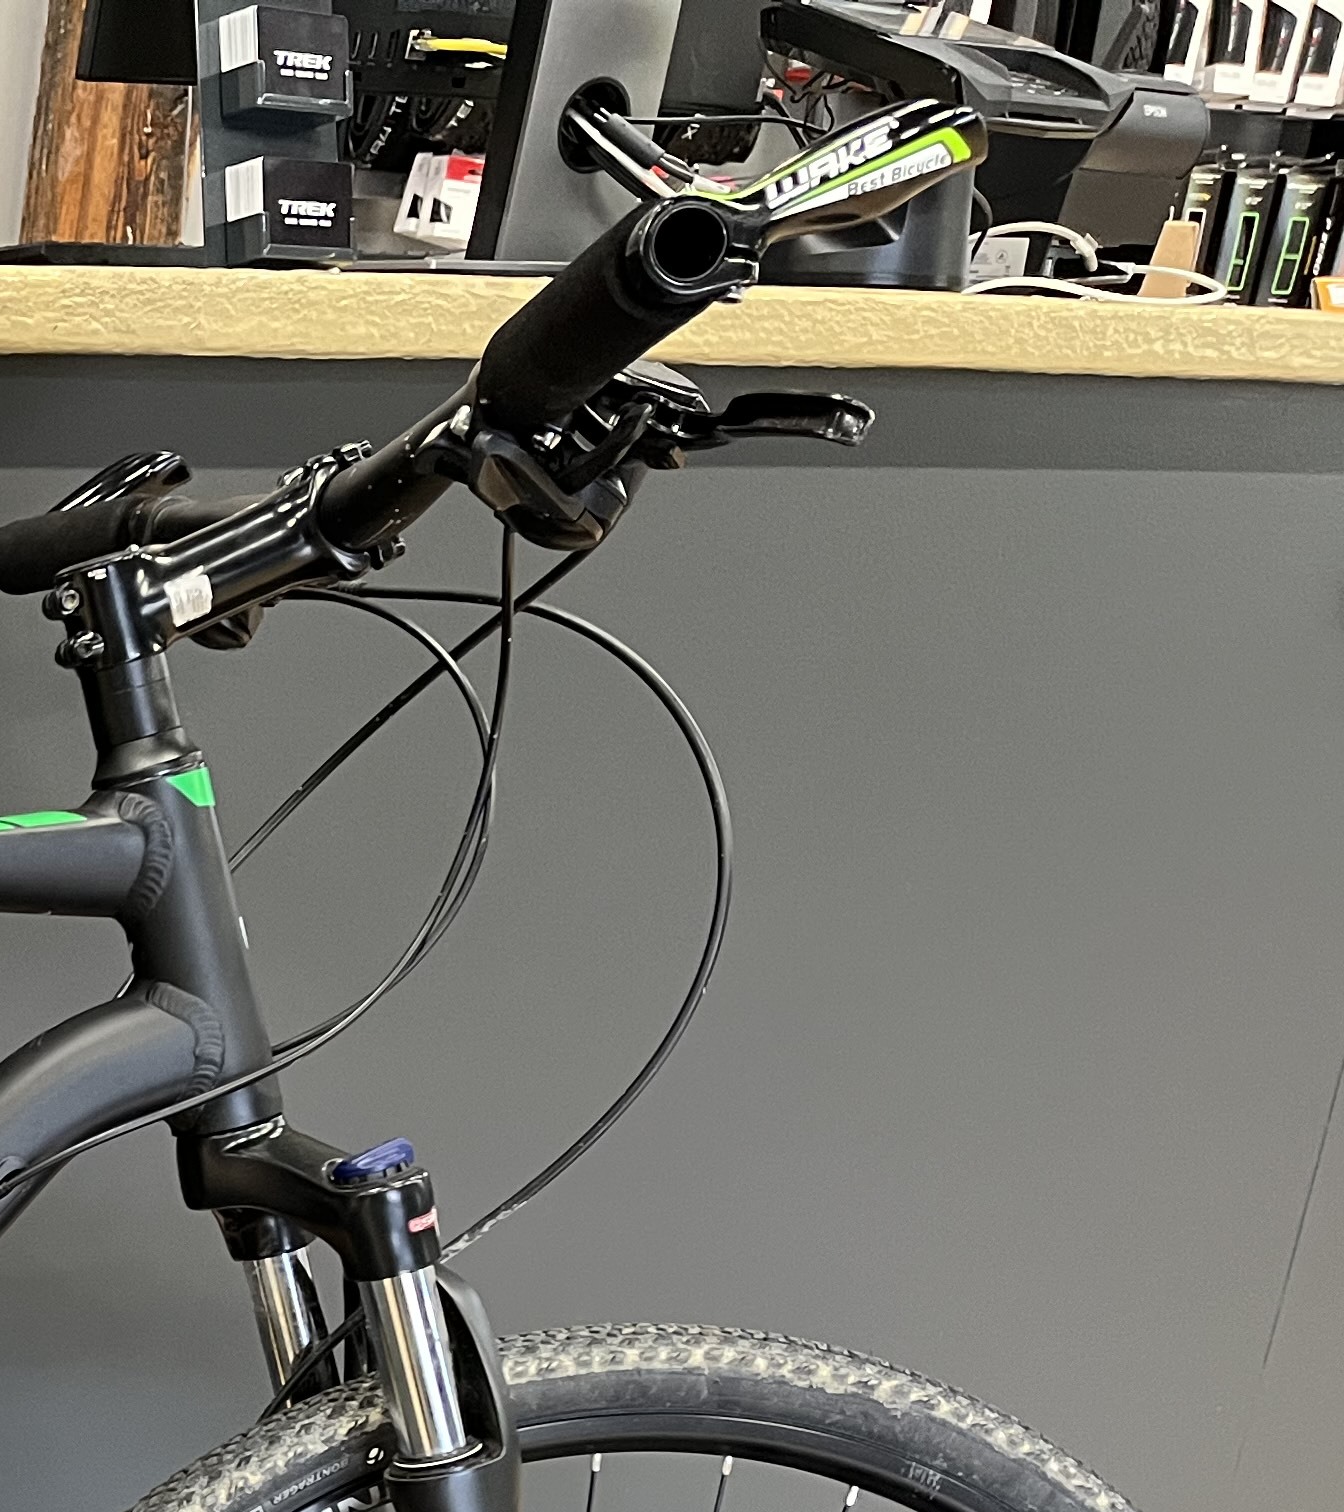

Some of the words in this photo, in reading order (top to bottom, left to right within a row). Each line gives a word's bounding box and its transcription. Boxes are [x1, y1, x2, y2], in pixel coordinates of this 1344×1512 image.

[273, 50, 332, 70] TREK
[847, 174, 884, 197] Best
[891, 152, 949, 181] Bicycle
[278, 199, 336, 217] TREK
[273, 1458, 350, 1505] BONTRAGER
